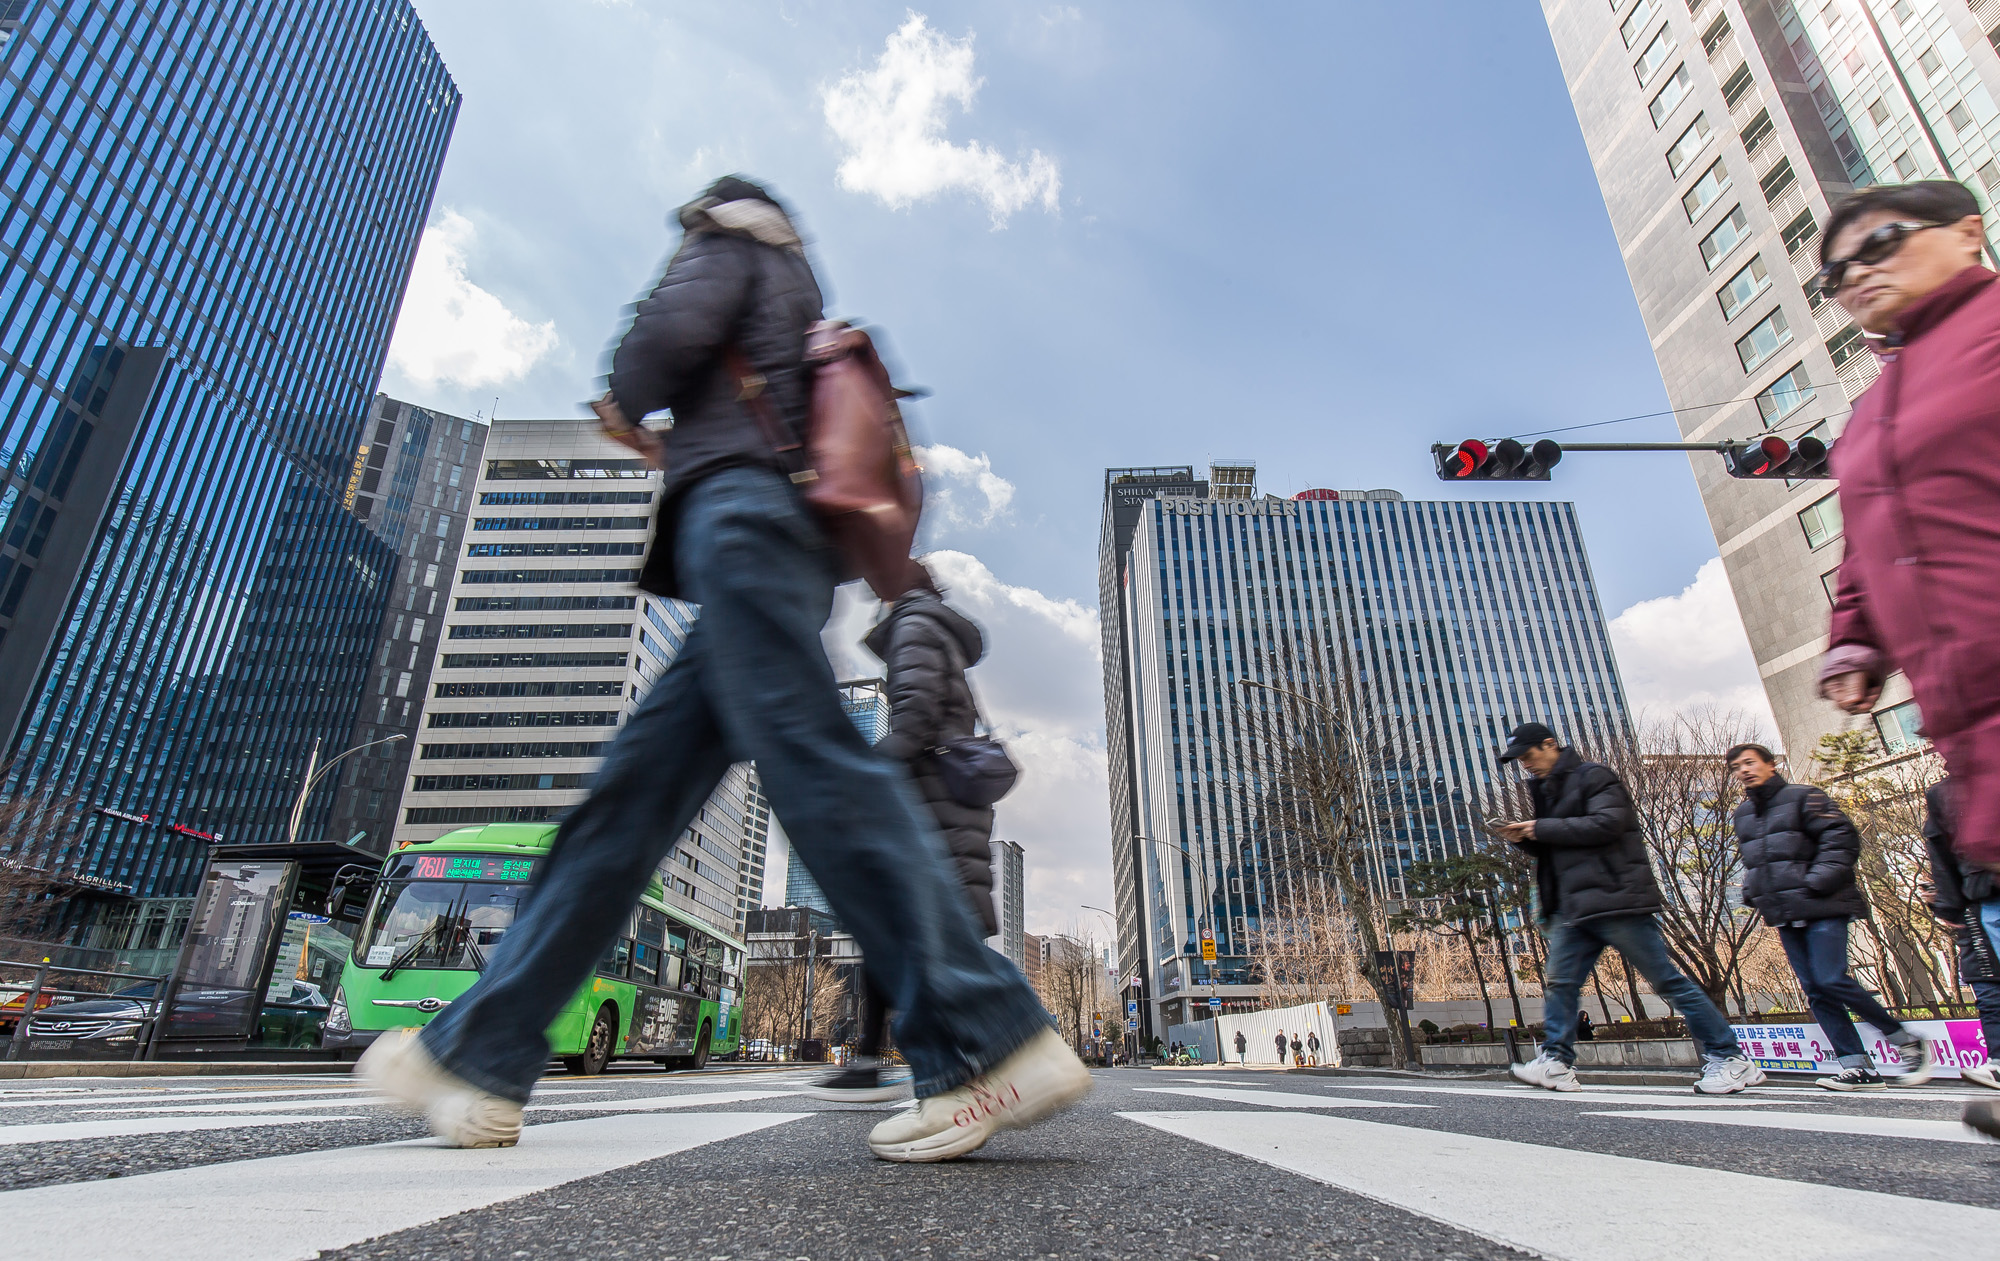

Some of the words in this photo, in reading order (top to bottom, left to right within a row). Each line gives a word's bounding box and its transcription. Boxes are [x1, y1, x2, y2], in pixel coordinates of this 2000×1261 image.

[1117, 488, 1154, 496] SHILLA
[1162, 499, 1215, 516] POST
[1220, 500, 1297, 516] TOWER
[104, 807, 122, 817] ASIANA
[122, 812, 143, 822] AIRLINES
[418, 856, 447, 878] 7611
[453, 858, 481, 868] 명지대
[73, 872, 123, 888] LAGRILLIA
[706, 984, 718, 1000] 7611
[1746, 1027, 1766, 1039] 마포
[1767, 1027, 1805, 1039] 공덕역점
[1772, 1041, 1802, 1058] 혜택
[953, 1081, 1021, 1128] GUCCI
